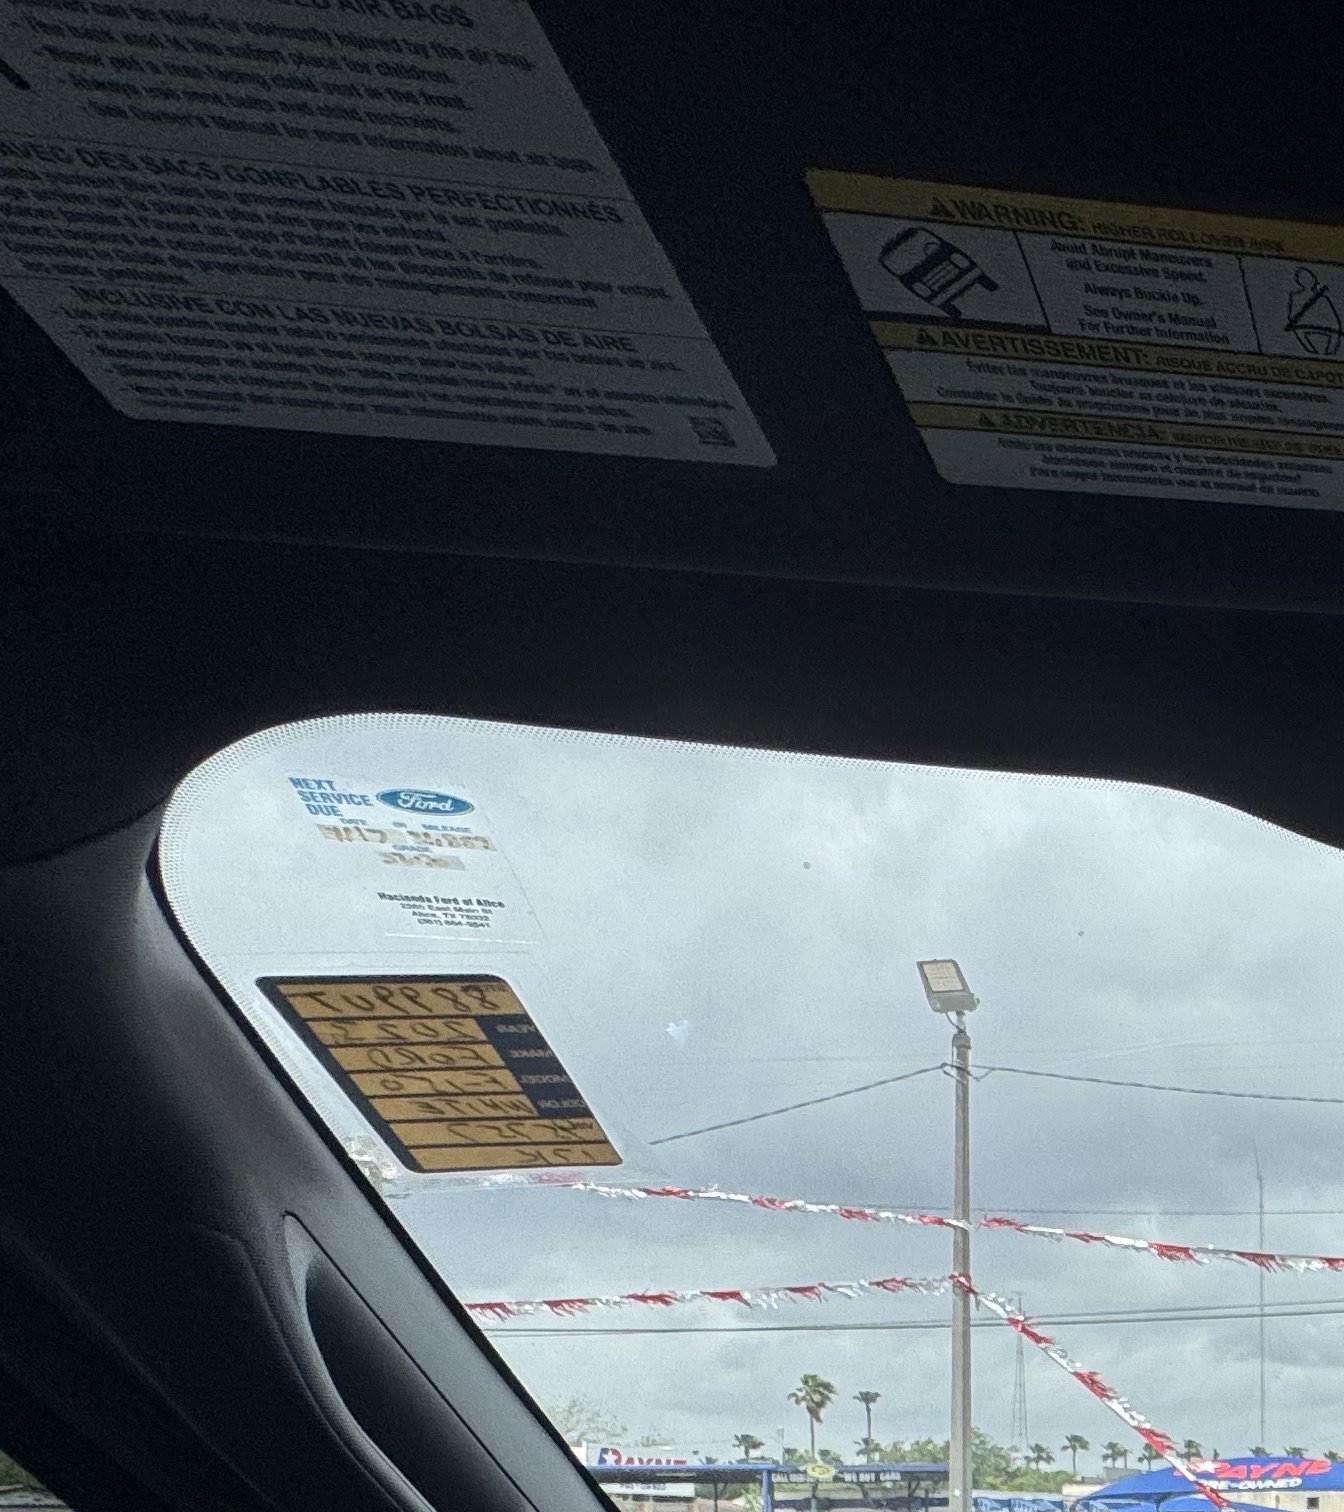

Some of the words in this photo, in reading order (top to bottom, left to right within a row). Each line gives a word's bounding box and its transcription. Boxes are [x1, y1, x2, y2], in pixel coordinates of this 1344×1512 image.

[388, 0, 474, 28] BAGS
[139, 155, 221, 181] SACS
[221, 163, 403, 202] GONFLABLES
[406, 183, 623, 223] PERFECTIONNÉS
[950, 201, 1085, 232] WARNING:
[1091, 222, 1158, 242] HIGHER
[1049, 239, 1088, 256] Avoid
[1089, 243, 1138, 263] Abrupt
[1066, 258, 1093, 273] and
[1094, 261, 1159, 280] Excessive
[1083, 282, 1133, 300] Always
[1134, 286, 1179, 303] Buckle
[70, 286, 215, 315] INCLUSIVE
[215, 301, 275, 320] CON
[276, 304, 329, 325] LAS
[440, 316, 540, 344] BOLSAS
[580, 331, 636, 352] AIRE
[1083, 304, 1109, 319] See
[1110, 307, 1167, 325] Owner's
[1167, 313, 1217, 329] Manual
[1077, 318, 1102, 333] For
[1103, 322, 1154, 338] Further
[1155, 326, 1230, 346] Information
[940, 332, 1149, 367] AVERTISSEMENT:
[1156, 354, 1212, 371] RISQUE
[288, 777, 337, 792] NEXT
[297, 790, 374, 807] SERVICE
[304, 803, 343, 818] DUE
[396, 792, 455, 812] Ford
[433, 895, 460, 906] Ford
